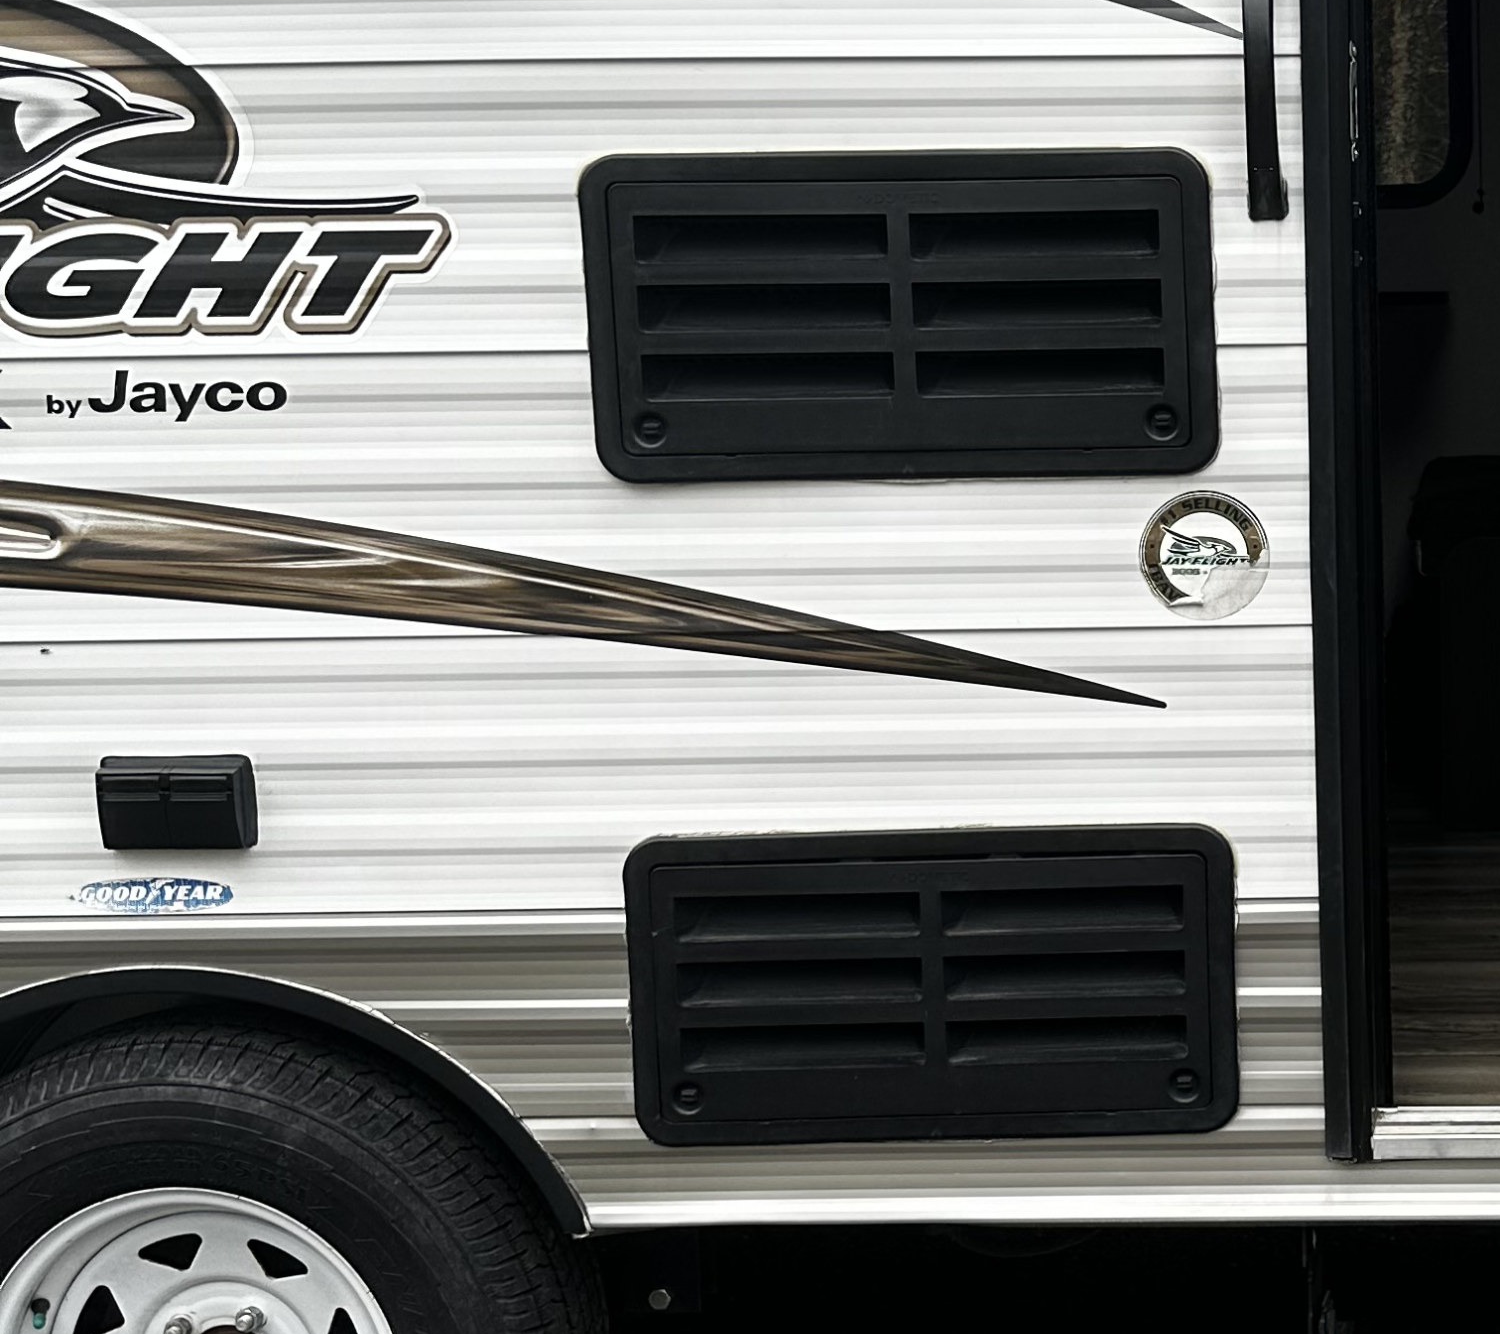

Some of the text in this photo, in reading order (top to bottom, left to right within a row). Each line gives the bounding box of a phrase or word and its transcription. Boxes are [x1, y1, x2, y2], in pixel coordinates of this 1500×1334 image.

[46, 395, 82, 419] by
[87, 369, 288, 422] Jayco
[1181, 497, 1253, 532] SELLING
[1162, 556, 1191, 565] JAY
